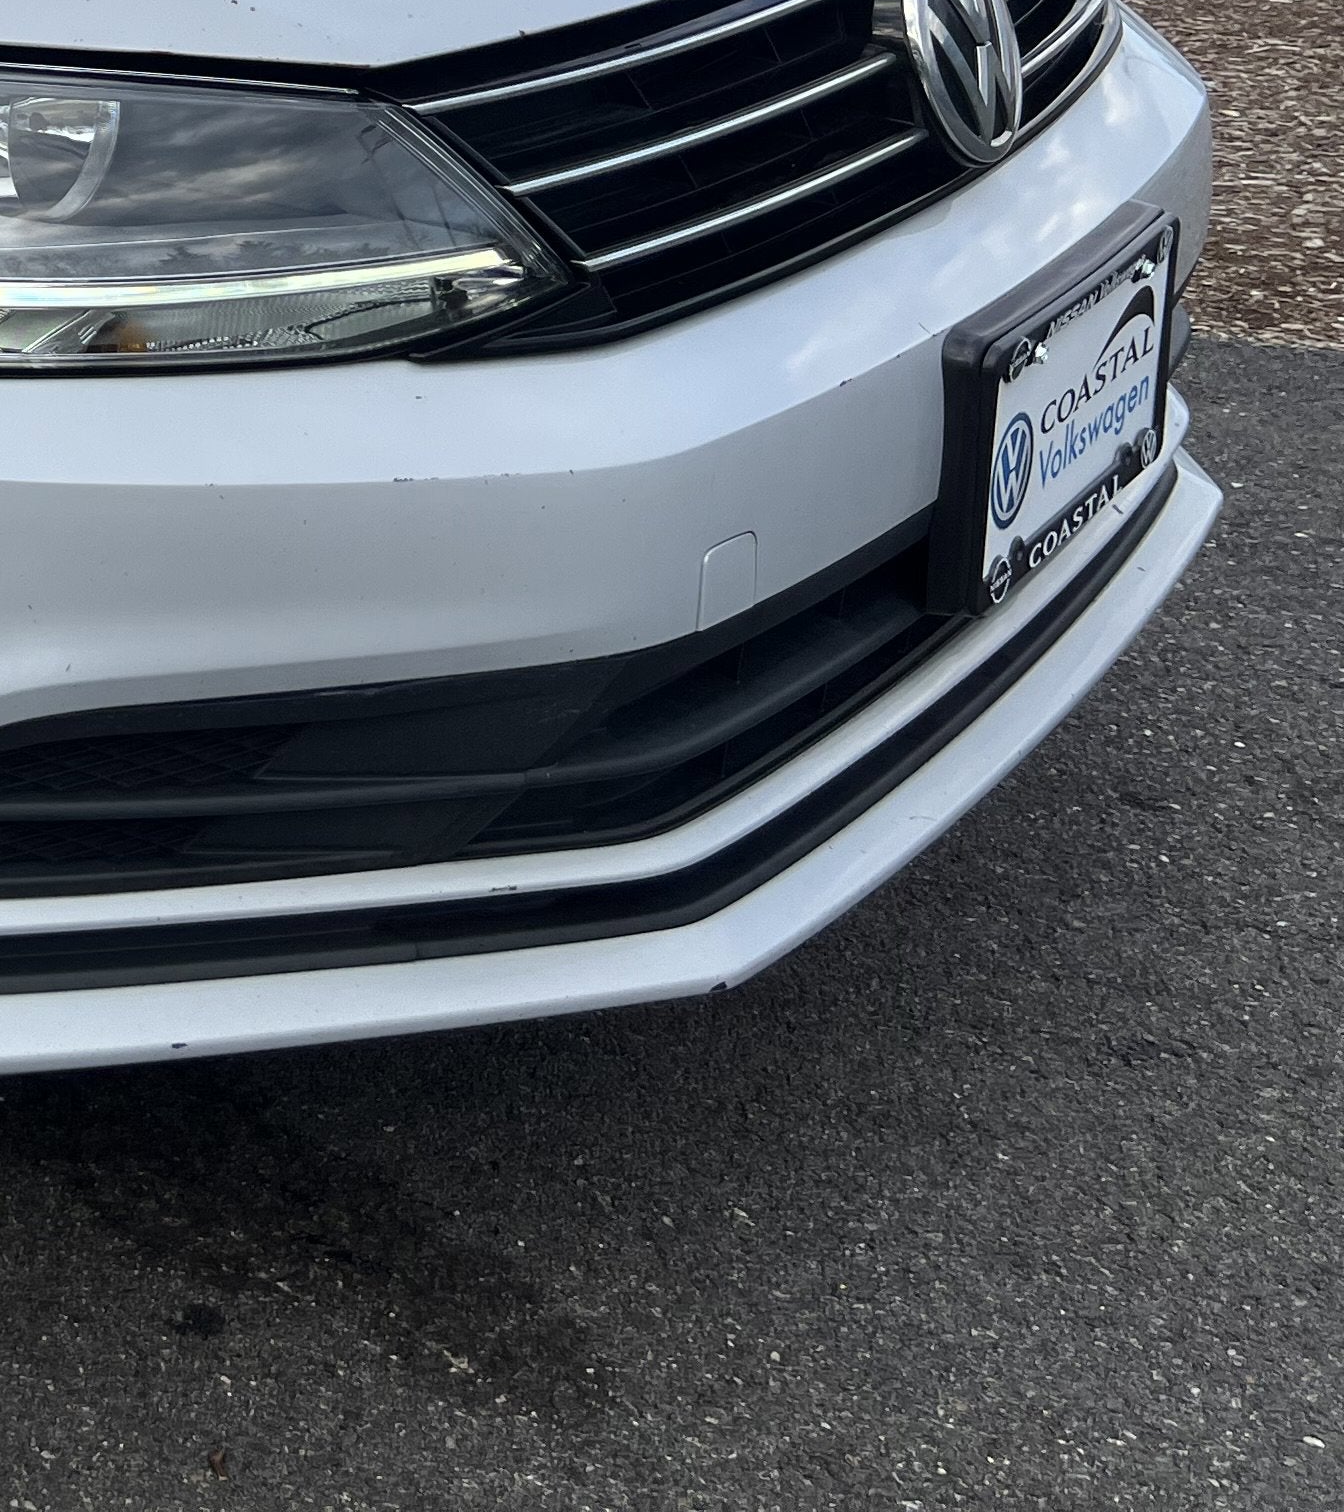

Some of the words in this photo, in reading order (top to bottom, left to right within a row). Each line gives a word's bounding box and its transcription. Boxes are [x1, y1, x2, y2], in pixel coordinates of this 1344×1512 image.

[1039, 375, 1150, 489] Volkswagen
[1040, 326, 1154, 434] COASTAL
[992, 413, 1033, 529] VW
[1028, 474, 1124, 568] COASTAL
